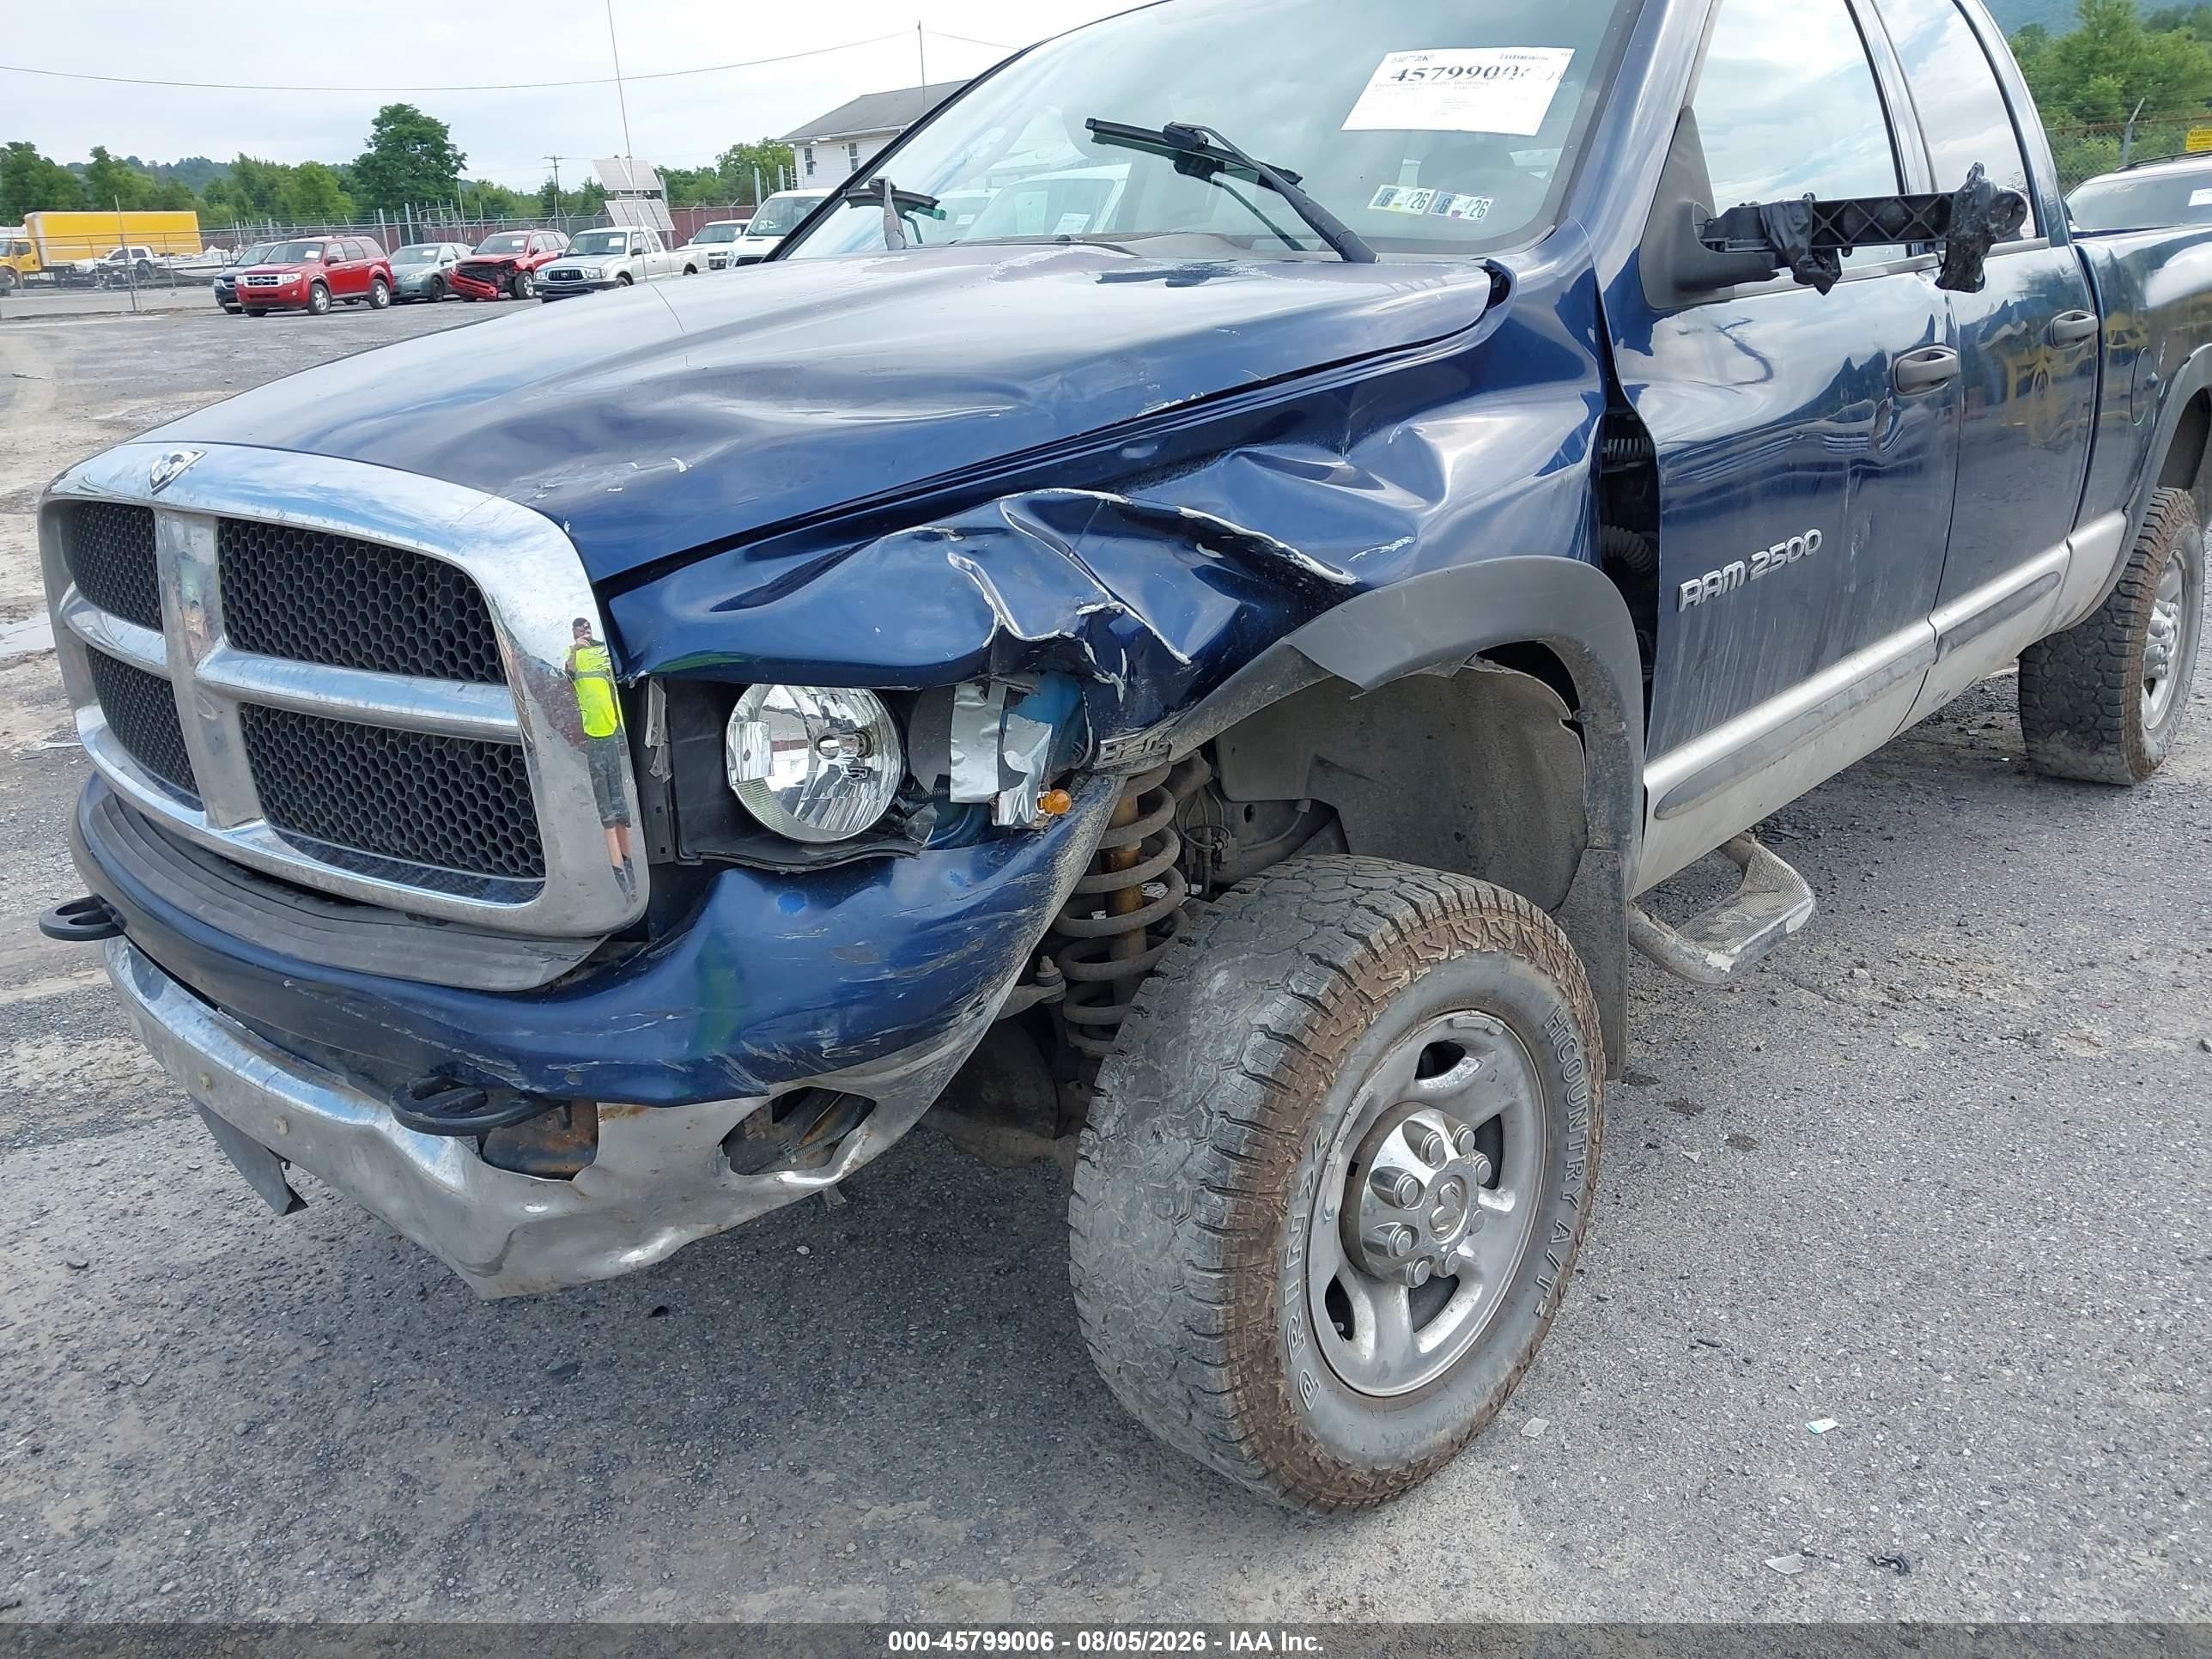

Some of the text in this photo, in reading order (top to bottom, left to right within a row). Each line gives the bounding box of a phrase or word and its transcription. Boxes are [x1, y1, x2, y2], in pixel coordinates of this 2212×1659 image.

[1410, 191, 1431, 210] 26
[1469, 199, 1490, 219] 26
[1679, 528, 1823, 613] RAM 2500
[1283, 1126, 1333, 1413] PRINX
